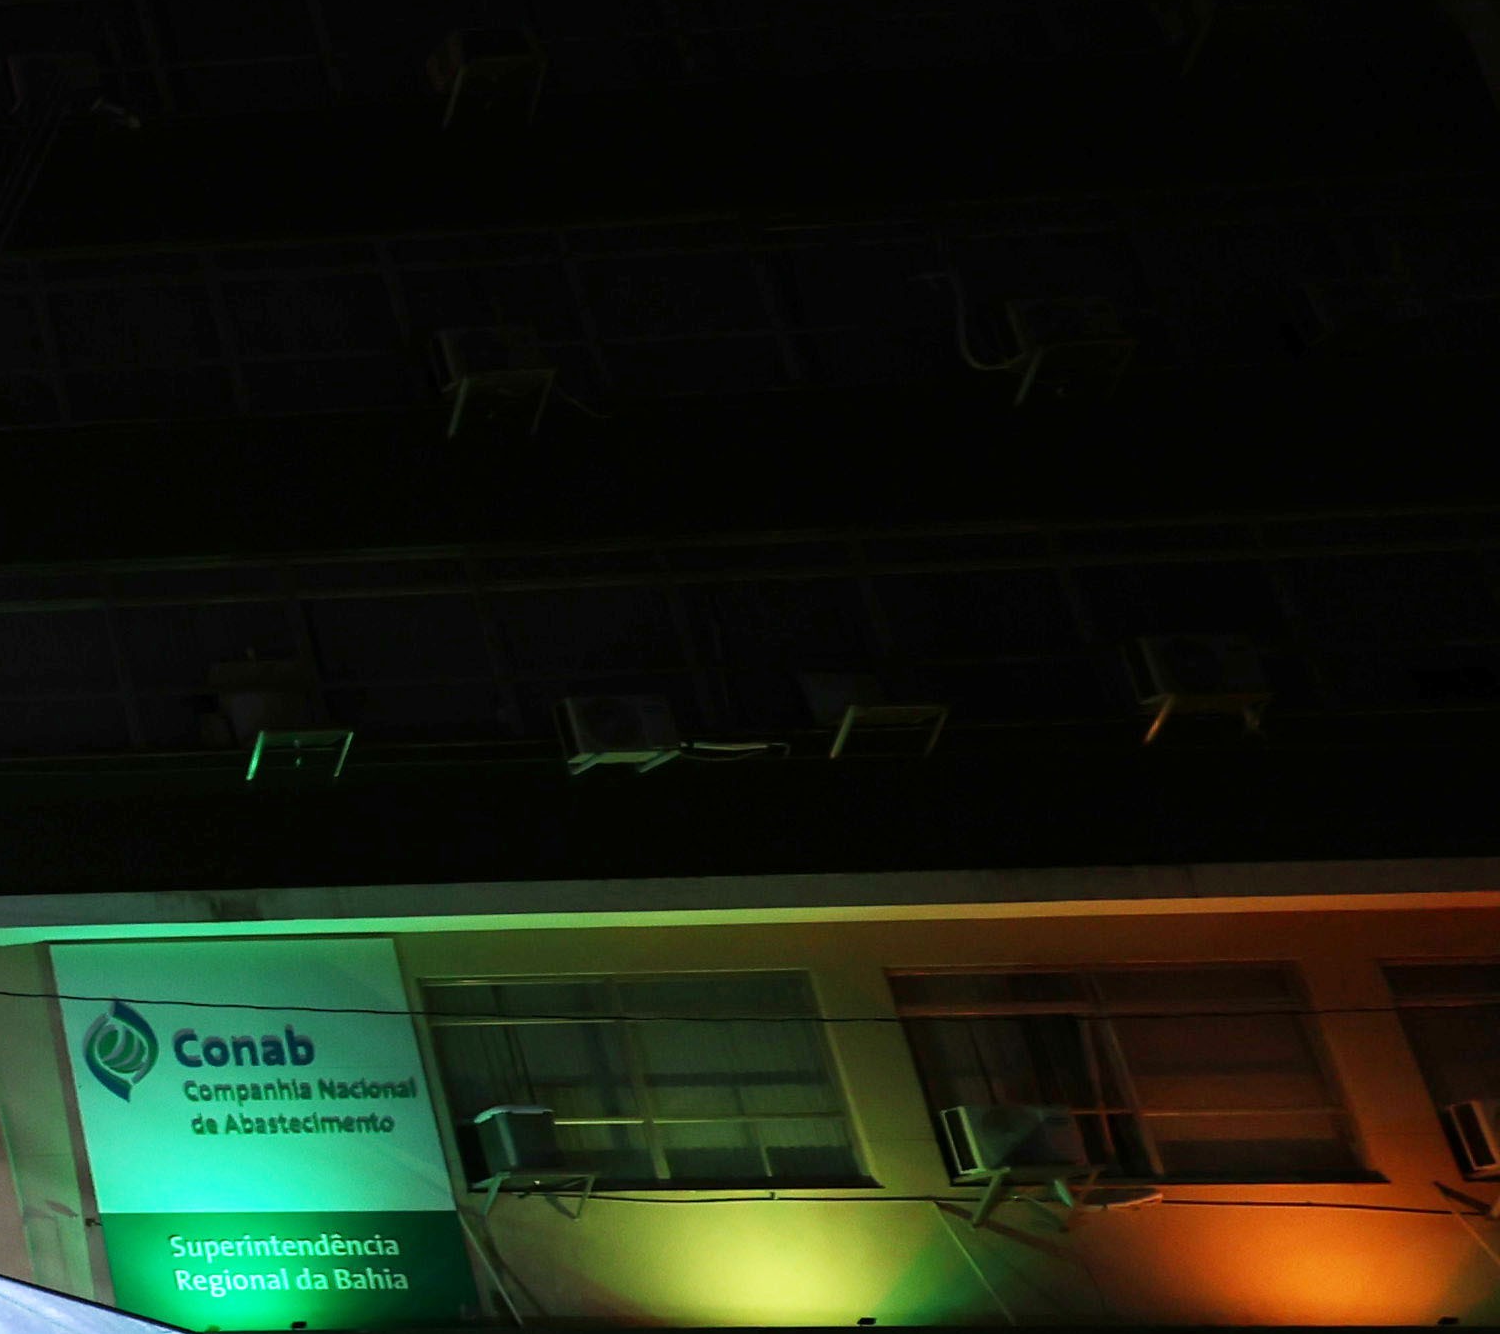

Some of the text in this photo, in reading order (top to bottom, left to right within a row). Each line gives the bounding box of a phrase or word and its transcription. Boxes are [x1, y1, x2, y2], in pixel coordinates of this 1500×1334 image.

[172, 1024, 316, 1068] Conab
[183, 1076, 418, 1107] Companhia Nacional
[191, 1111, 395, 1136] de Abastecimento
[170, 1233, 400, 1264] Superintendência
[175, 1265, 409, 1297] Regional da Bahia
